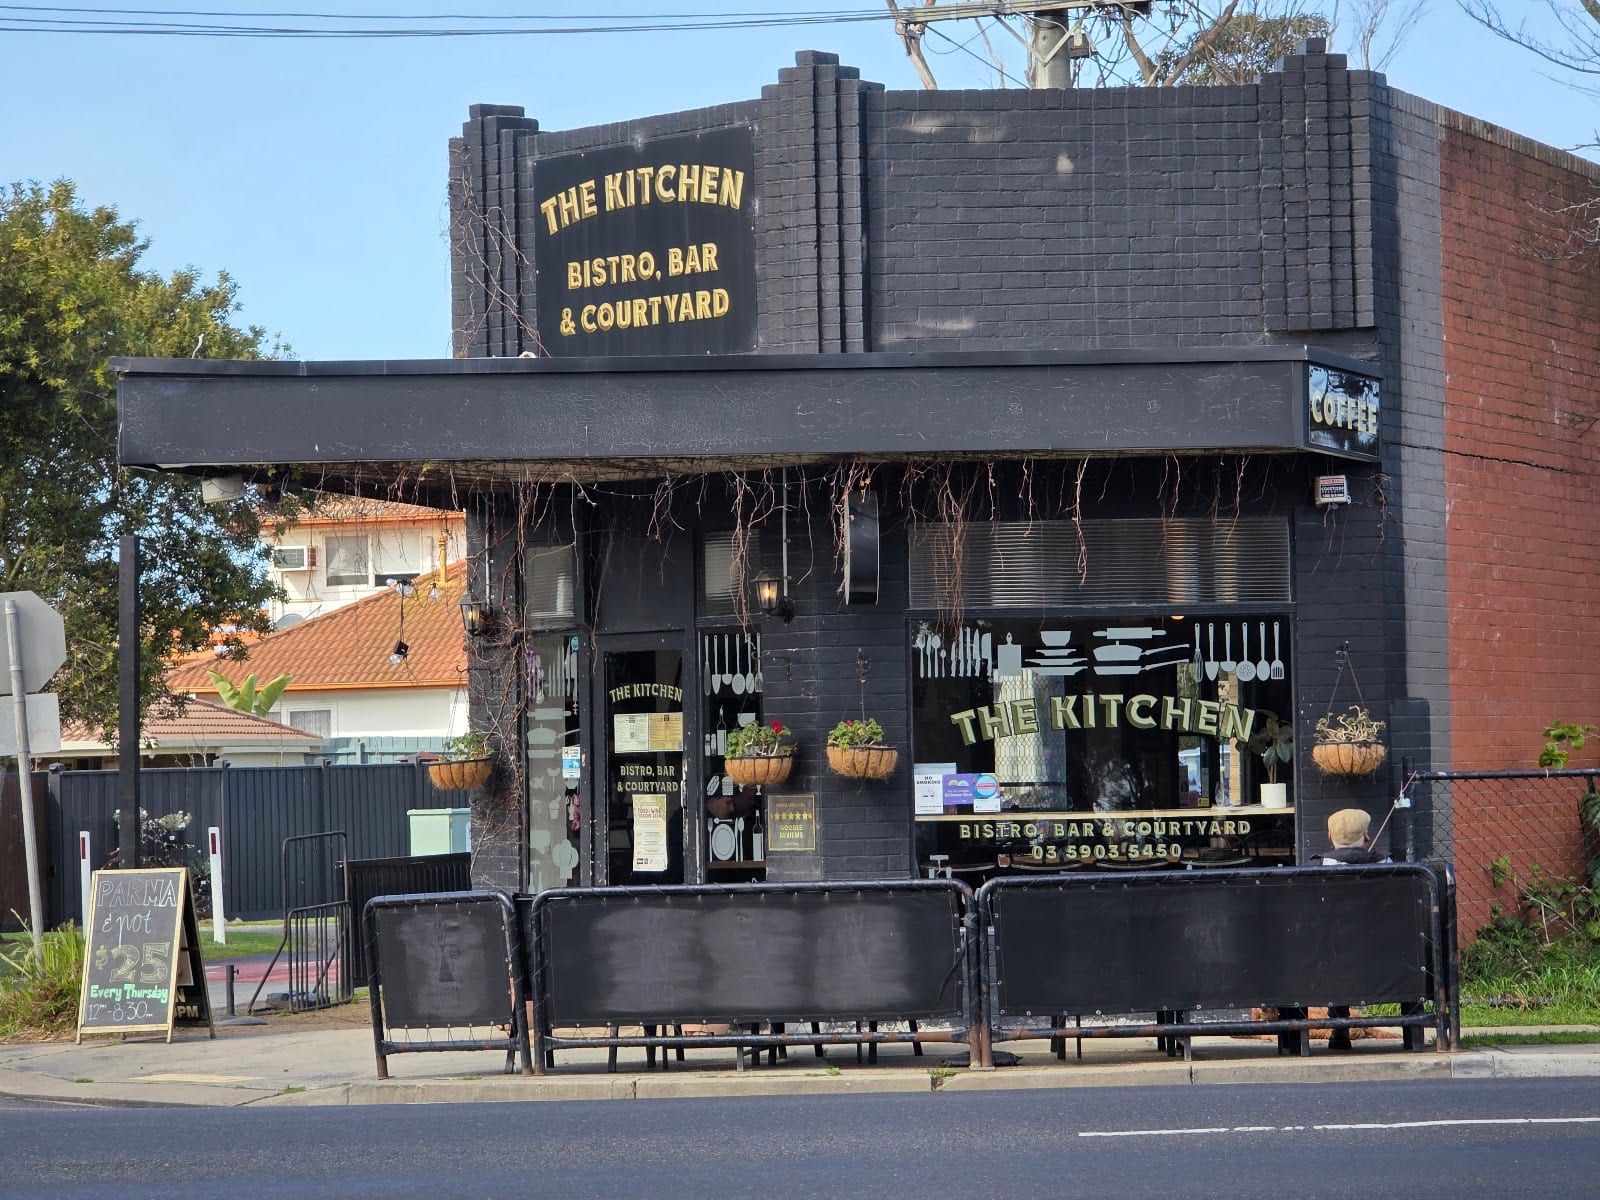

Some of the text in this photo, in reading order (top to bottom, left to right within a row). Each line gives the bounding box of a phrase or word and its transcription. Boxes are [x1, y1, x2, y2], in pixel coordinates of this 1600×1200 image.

[540, 165, 745, 236] THE KITCHEN
[567, 243, 718, 290] BISTRO, BAR
[560, 288, 730, 336] & COURTYARD
[1311, 391, 1378, 435] COFFEE
[609, 683, 683, 703] THE KITCHEN
[951, 694, 1256, 746] THE KITCHEN
[617, 781, 679, 793] & COURTYARD
[620, 765, 675, 777] BISTRO, BAR
[1053, 822, 1095, 838] BAR
[1102, 822, 1115, 837] &
[1122, 820, 1251, 837] COURTYARD
[1031, 842, 1182, 860] 03 5903 5450
[97, 879, 177, 907] PARMA
[115, 909, 153, 949] pot
[95, 942, 171, 984] $25
[90, 984, 122, 1002] Every
[124, 983, 169, 1003] Thursday
